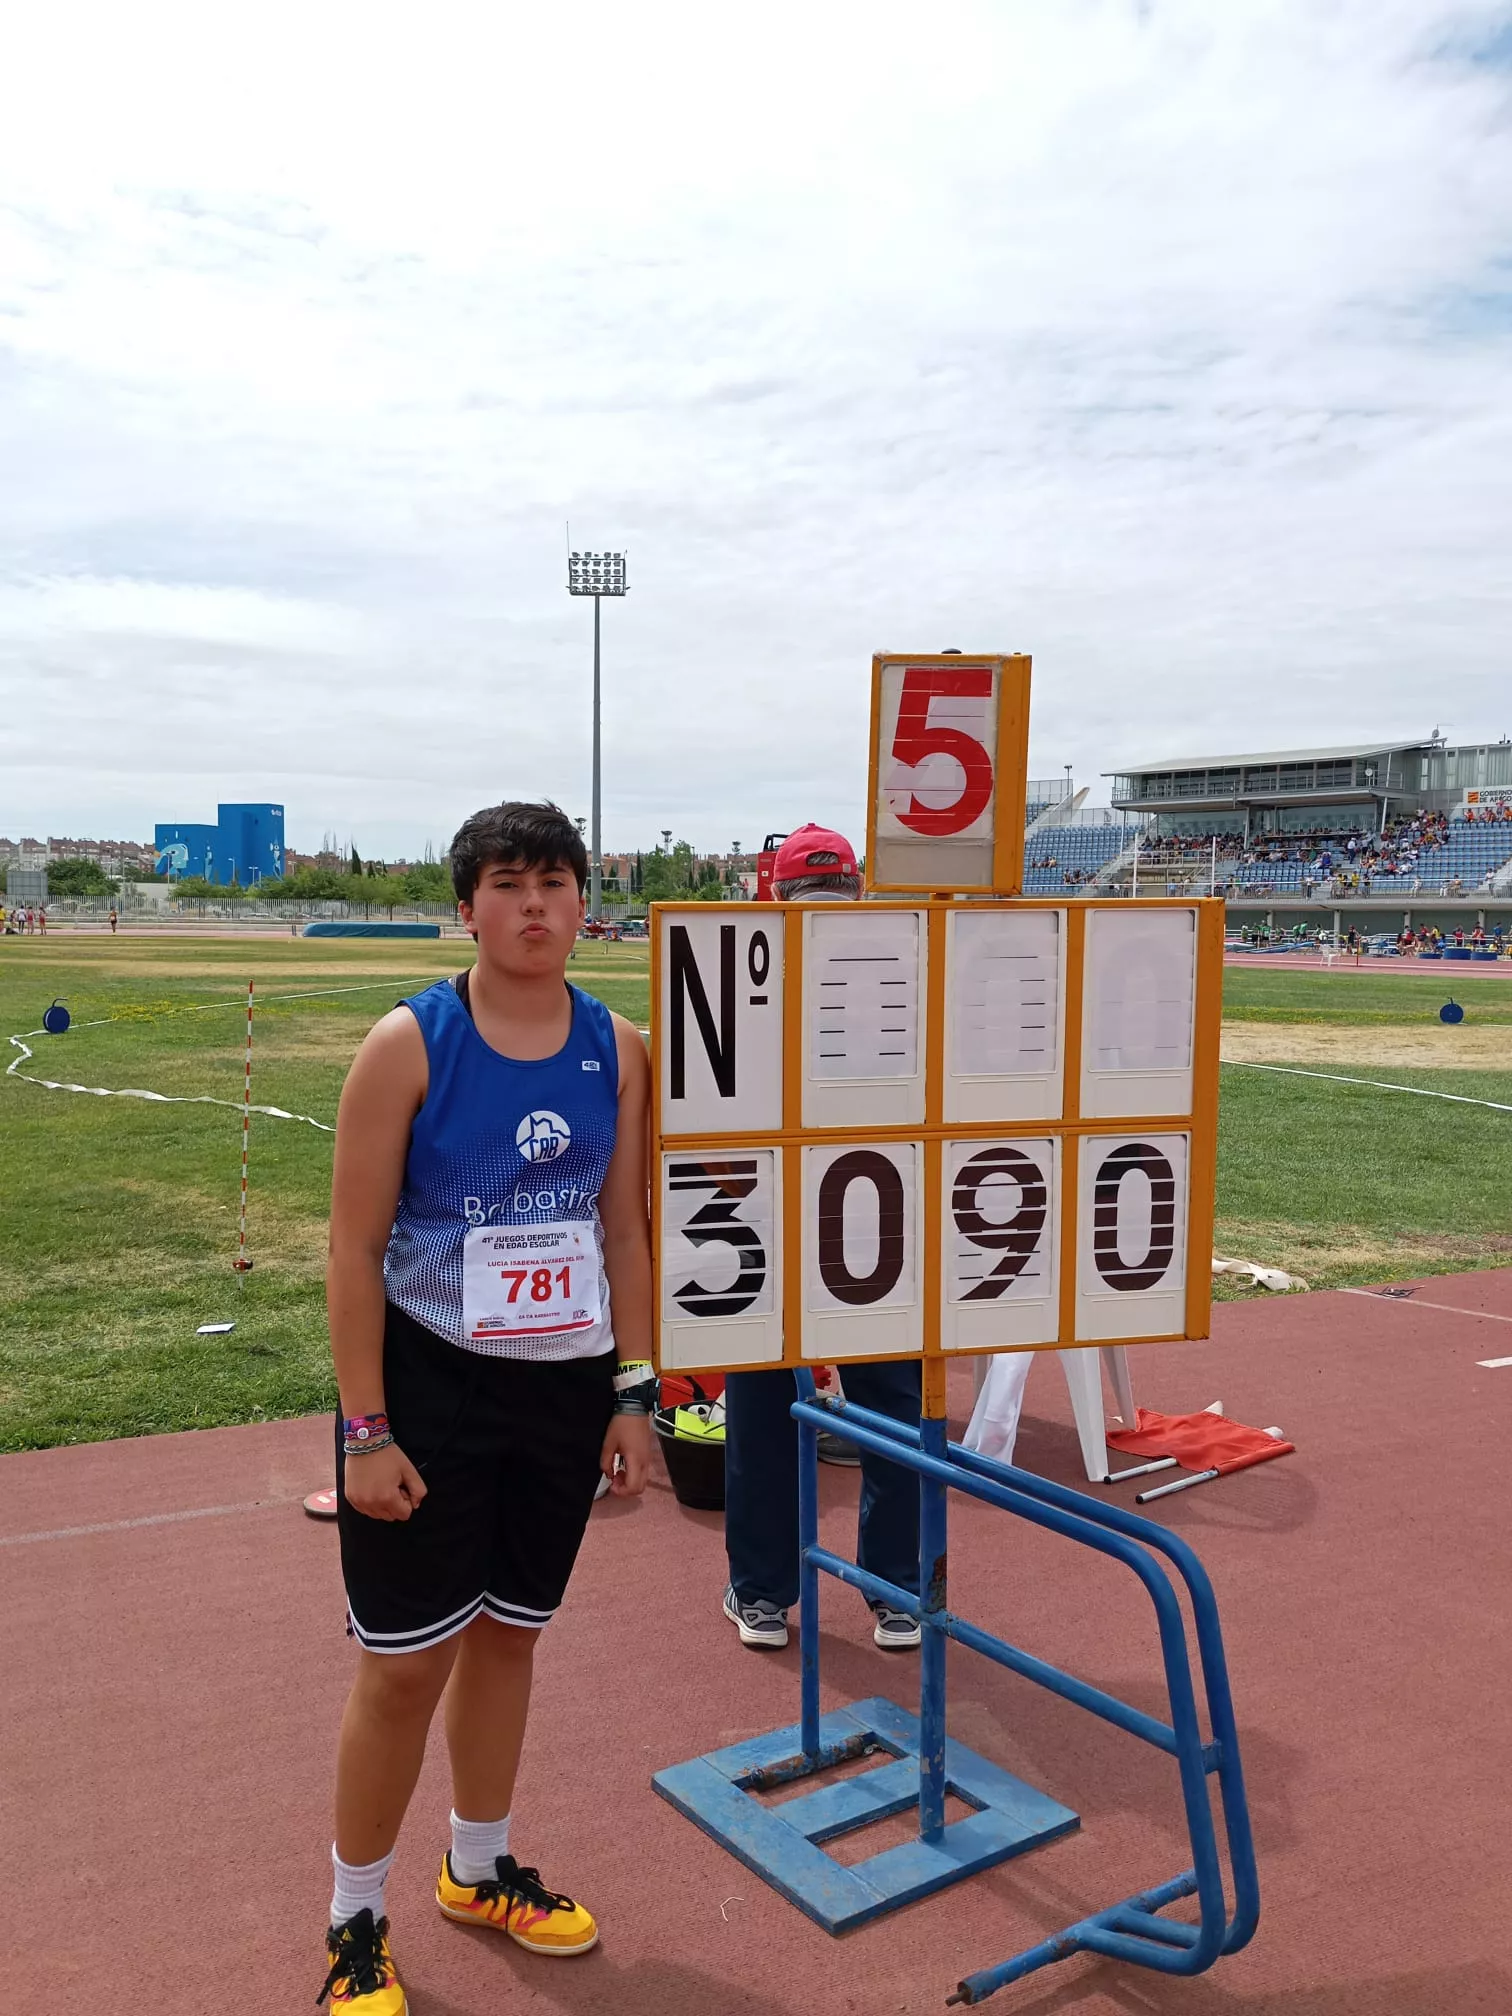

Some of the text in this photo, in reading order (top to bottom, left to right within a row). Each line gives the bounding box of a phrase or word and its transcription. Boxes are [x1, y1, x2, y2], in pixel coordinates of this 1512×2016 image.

[890, 667, 994, 837] 5
[529, 1137, 559, 1162] CAB
[495, 1235, 526, 1243] JUEGOS
[527, 1232, 568, 1241] DEPORTIVOS
[506, 1241, 528, 1249] EDAD
[529, 1240, 560, 1248] ESCOLAR
[501, 1265, 571, 1304] 781
